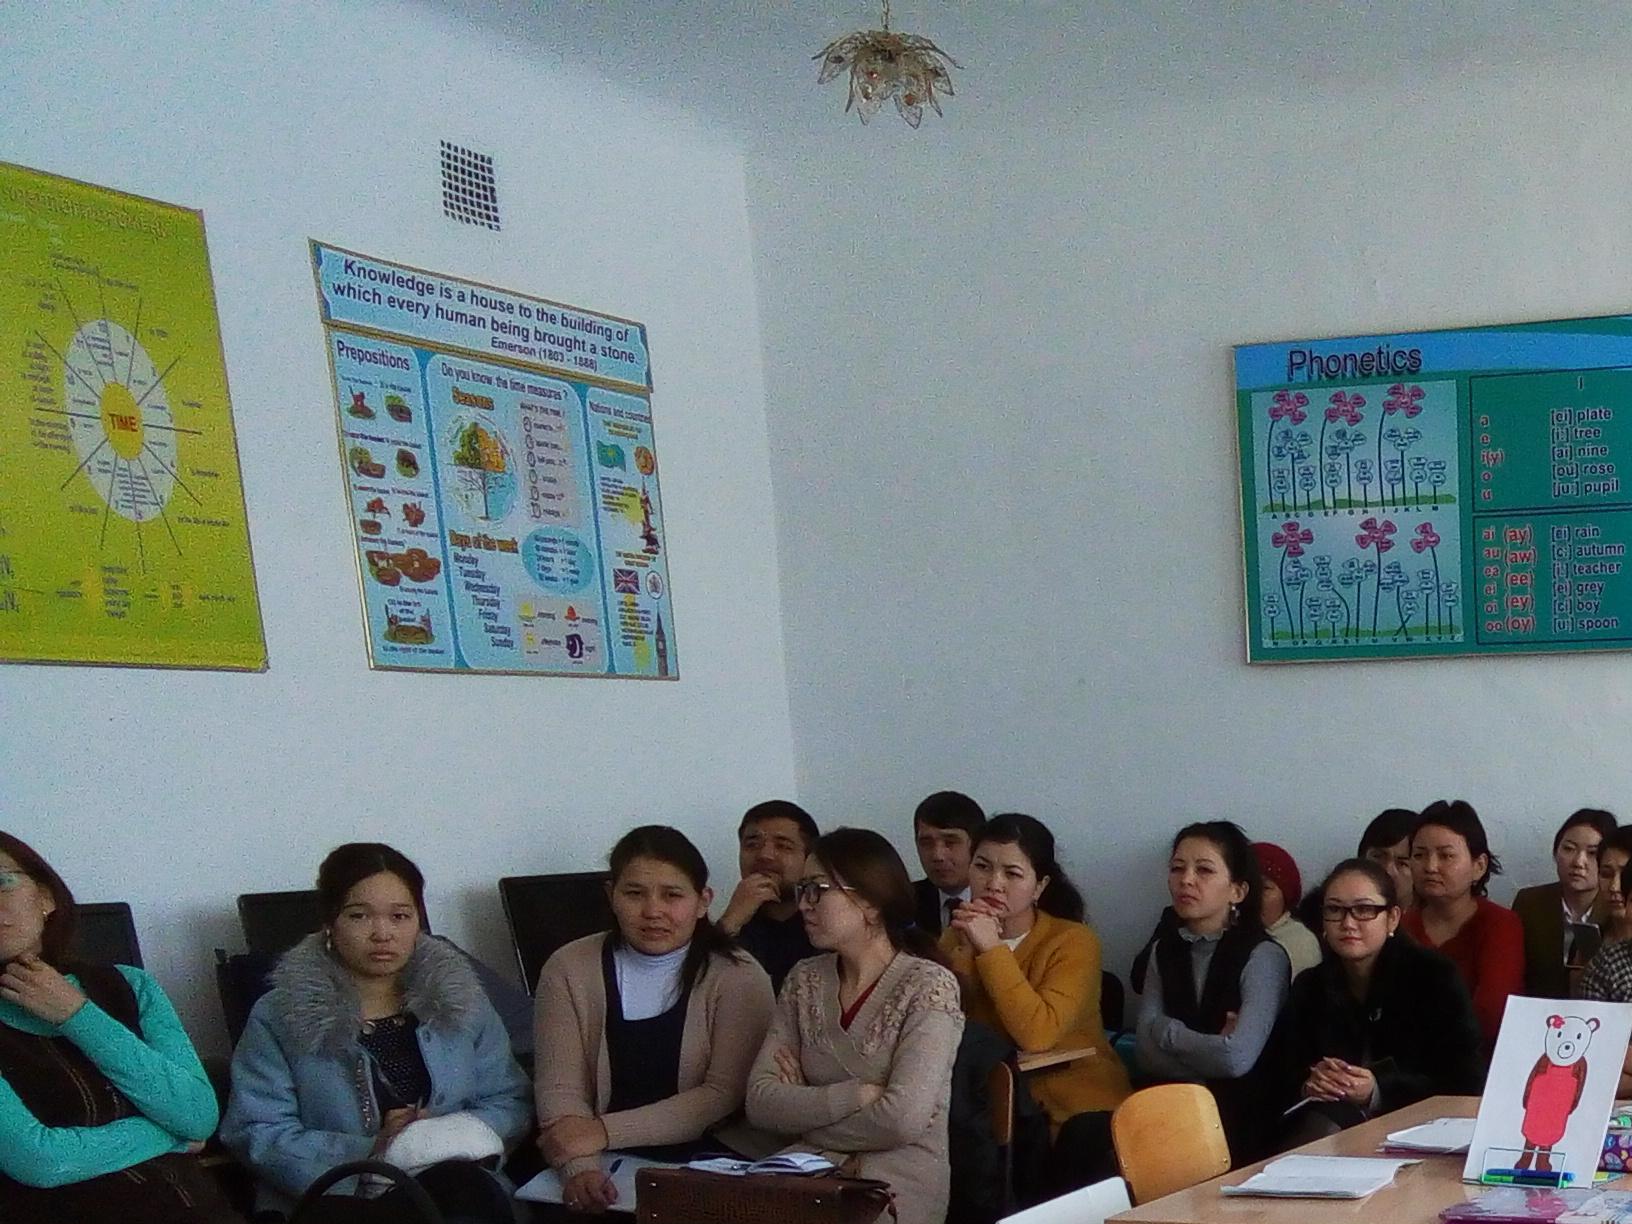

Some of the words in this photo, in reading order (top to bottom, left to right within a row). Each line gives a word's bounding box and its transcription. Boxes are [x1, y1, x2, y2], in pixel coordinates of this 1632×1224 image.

[344, 259, 434, 296] Knowledge
[440, 282, 451, 298] is
[457, 291, 465, 302] a
[470, 289, 514, 314] house
[519, 305, 532, 318] to
[536, 308, 557, 324] the
[561, 313, 612, 342] building
[616, 329, 629, 342] of
[333, 282, 381, 305] which
[388, 296, 429, 319] every
[436, 303, 486, 329] human
[491, 317, 529, 342] being
[534, 327, 586, 351] brought
[590, 344, 597, 354] a
[601, 347, 639, 363] stone.
[491, 337, 536, 356] Emerson
[336, 340, 410, 371] Prepositions
[1288, 344, 1422, 377] Phonetics
[1577, 408, 1612, 422] plate
[1574, 428, 1600, 439] tree
[1578, 445, 1608, 456] nine
[1584, 464, 1615, 473] rose
[1584, 480, 1618, 495] pupil
[1576, 524, 1599, 538] rain
[1577, 545, 1625, 557] autumn
[1573, 563, 1621, 575] teacher
[1577, 582, 1604, 595] grey
[1577, 600, 1600, 613] boy
[1579, 618, 1618, 631] spoon
